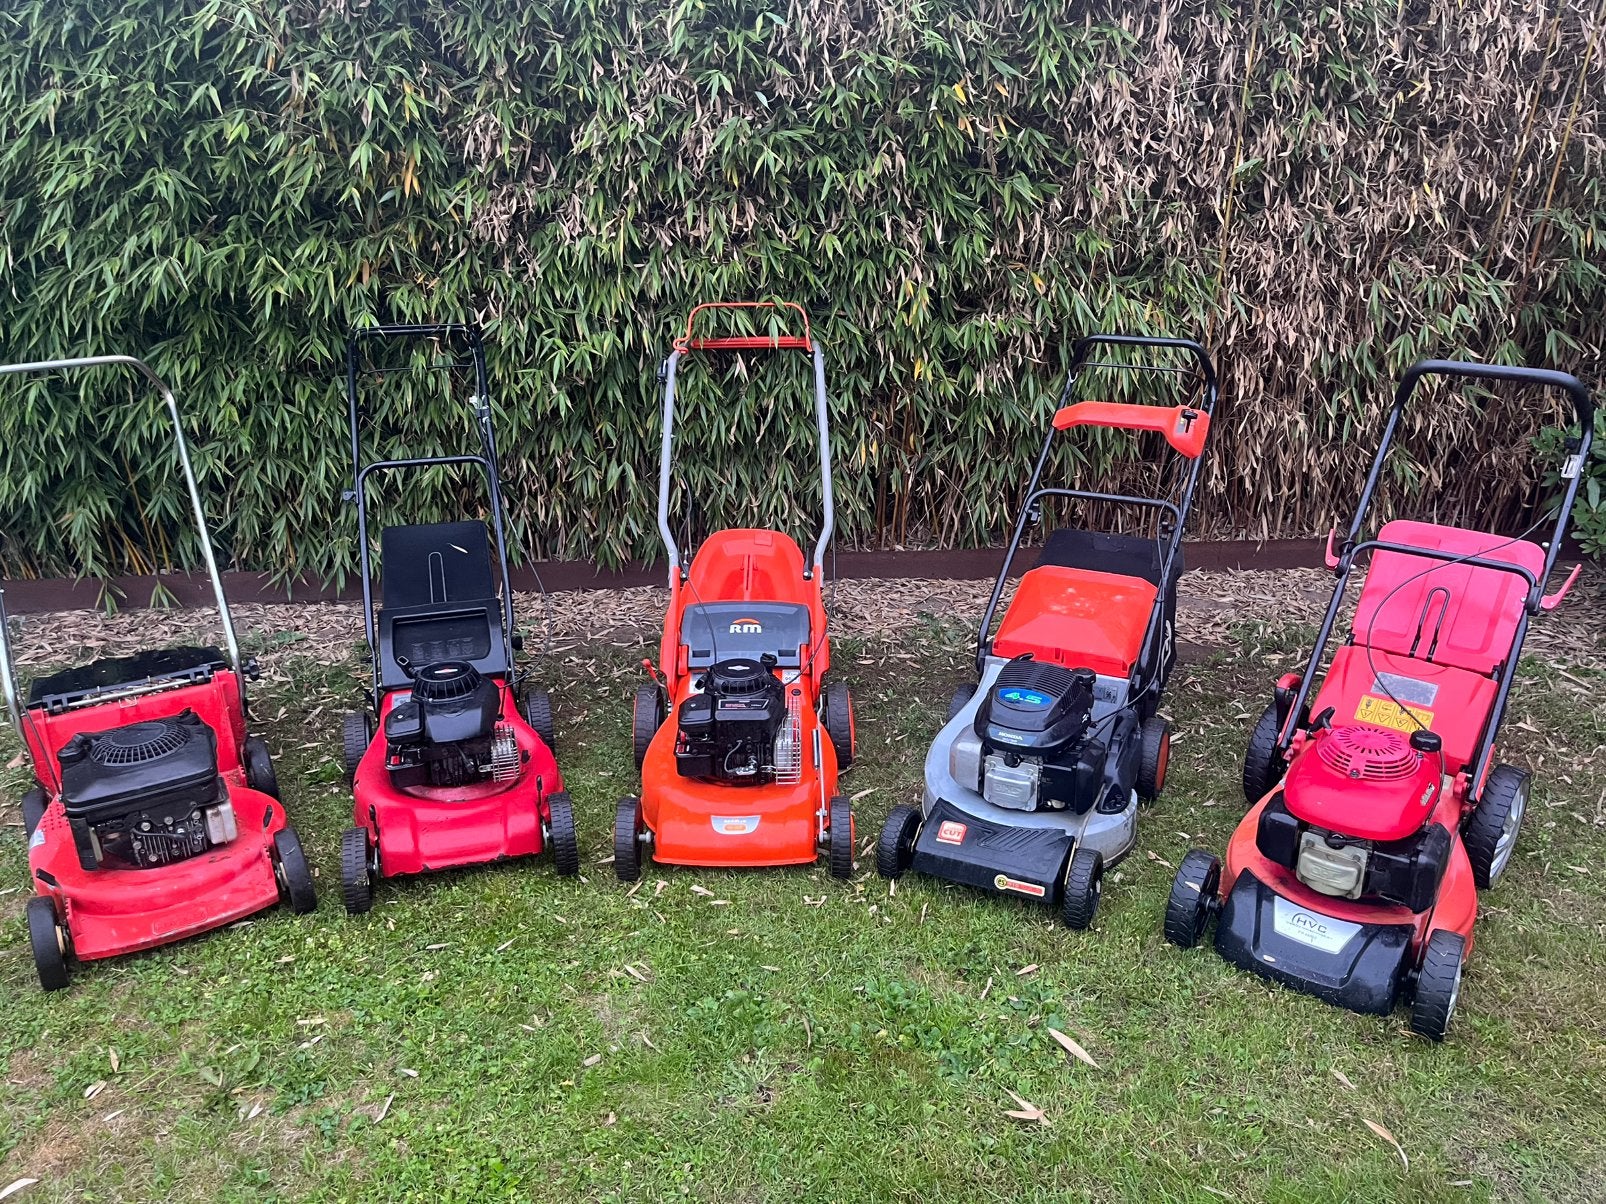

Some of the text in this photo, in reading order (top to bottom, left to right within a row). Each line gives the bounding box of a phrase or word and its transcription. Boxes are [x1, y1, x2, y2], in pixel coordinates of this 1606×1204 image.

[1004, 692, 1043, 704] 4.5
[998, 731, 1023, 741] HONDA
[943, 829, 962, 838] CUT
[1296, 916, 1328, 934] HVC
